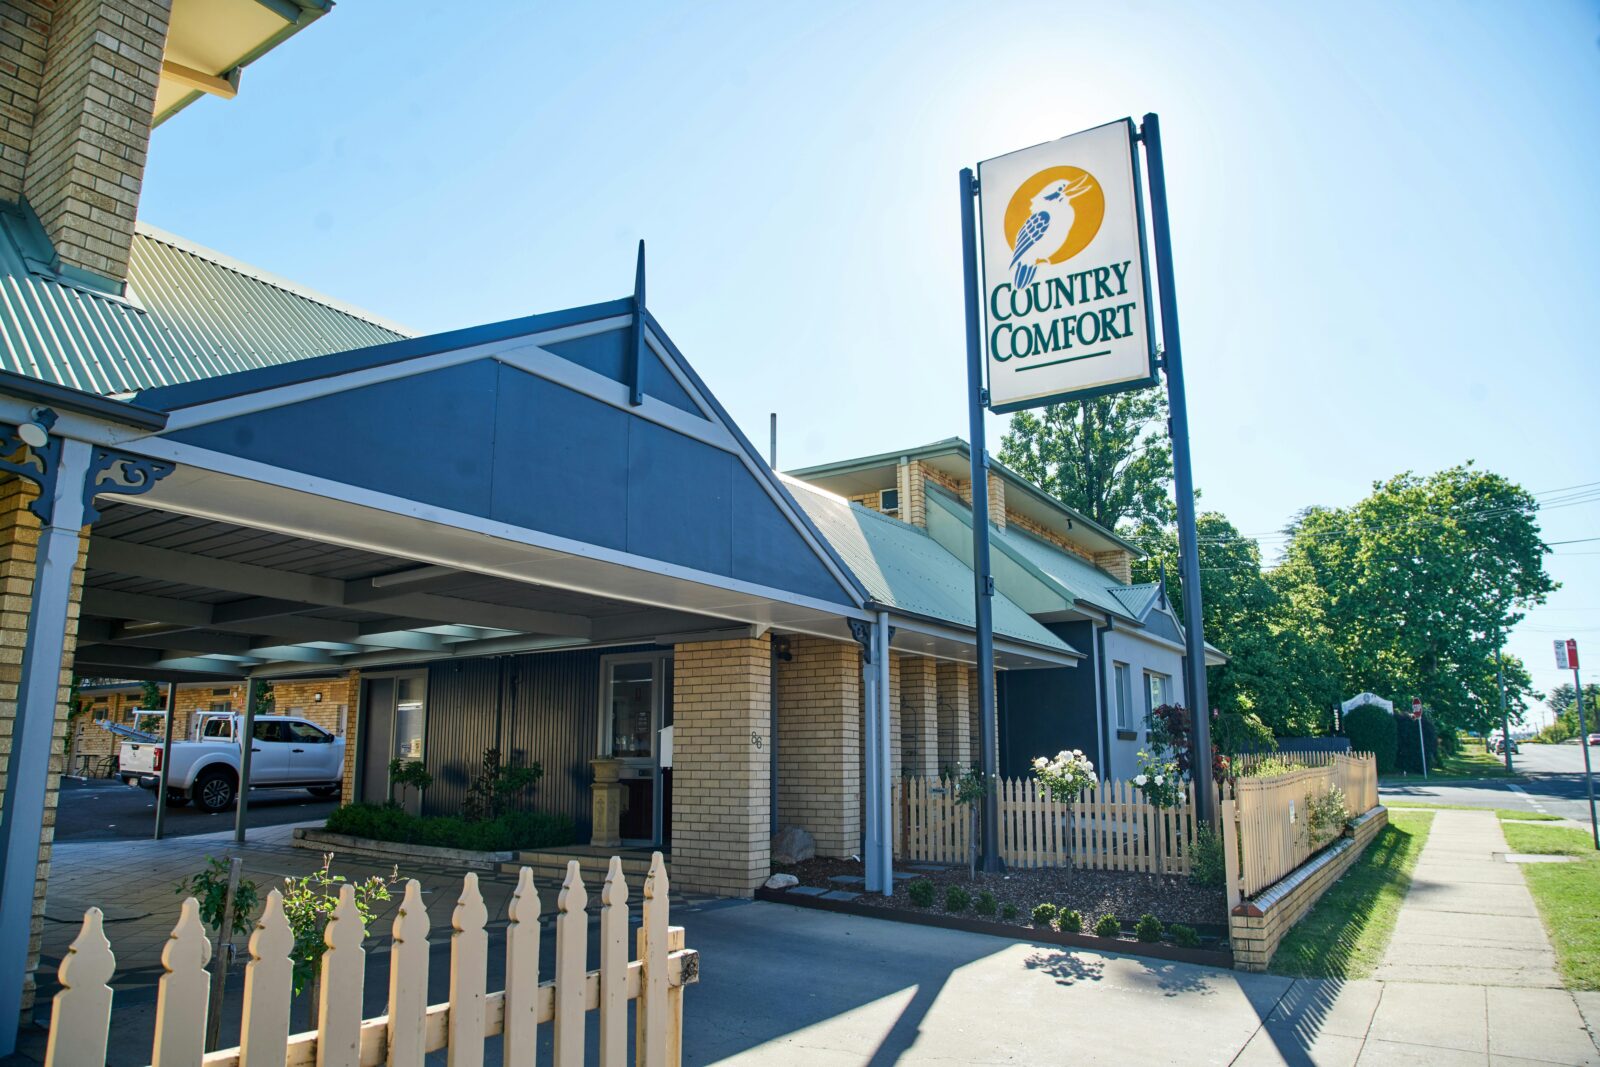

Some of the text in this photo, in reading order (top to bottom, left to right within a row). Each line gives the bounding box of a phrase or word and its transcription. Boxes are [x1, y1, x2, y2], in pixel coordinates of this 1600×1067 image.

[991, 261, 1131, 321] COUNTRY
[991, 303, 1136, 362] COMFORT
[751, 731, 762, 749] 86
